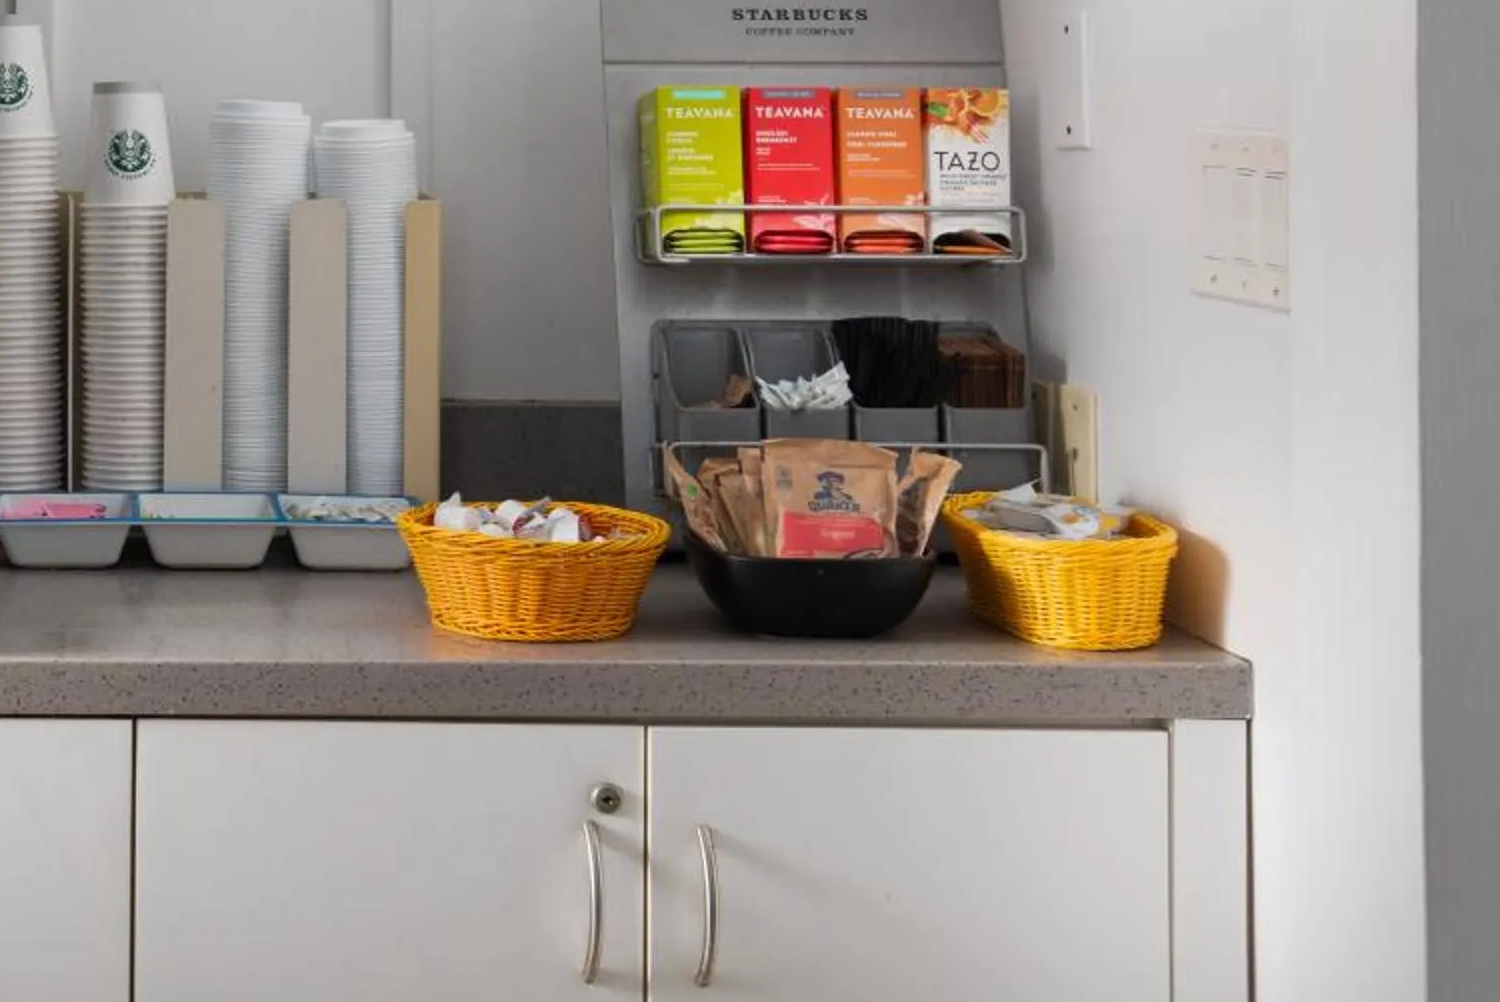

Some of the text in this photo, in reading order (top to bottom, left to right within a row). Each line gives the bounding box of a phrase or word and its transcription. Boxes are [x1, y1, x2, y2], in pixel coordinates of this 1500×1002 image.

[731, 8, 869, 21] STARBUCKS
[745, 27, 855, 36] COFFEE COMPANY
[665, 107, 735, 119] TEAVANA
[755, 106, 824, 119] TEAVANA
[845, 106, 915, 119] TEAVANA
[933, 151, 1001, 171] TAZO
